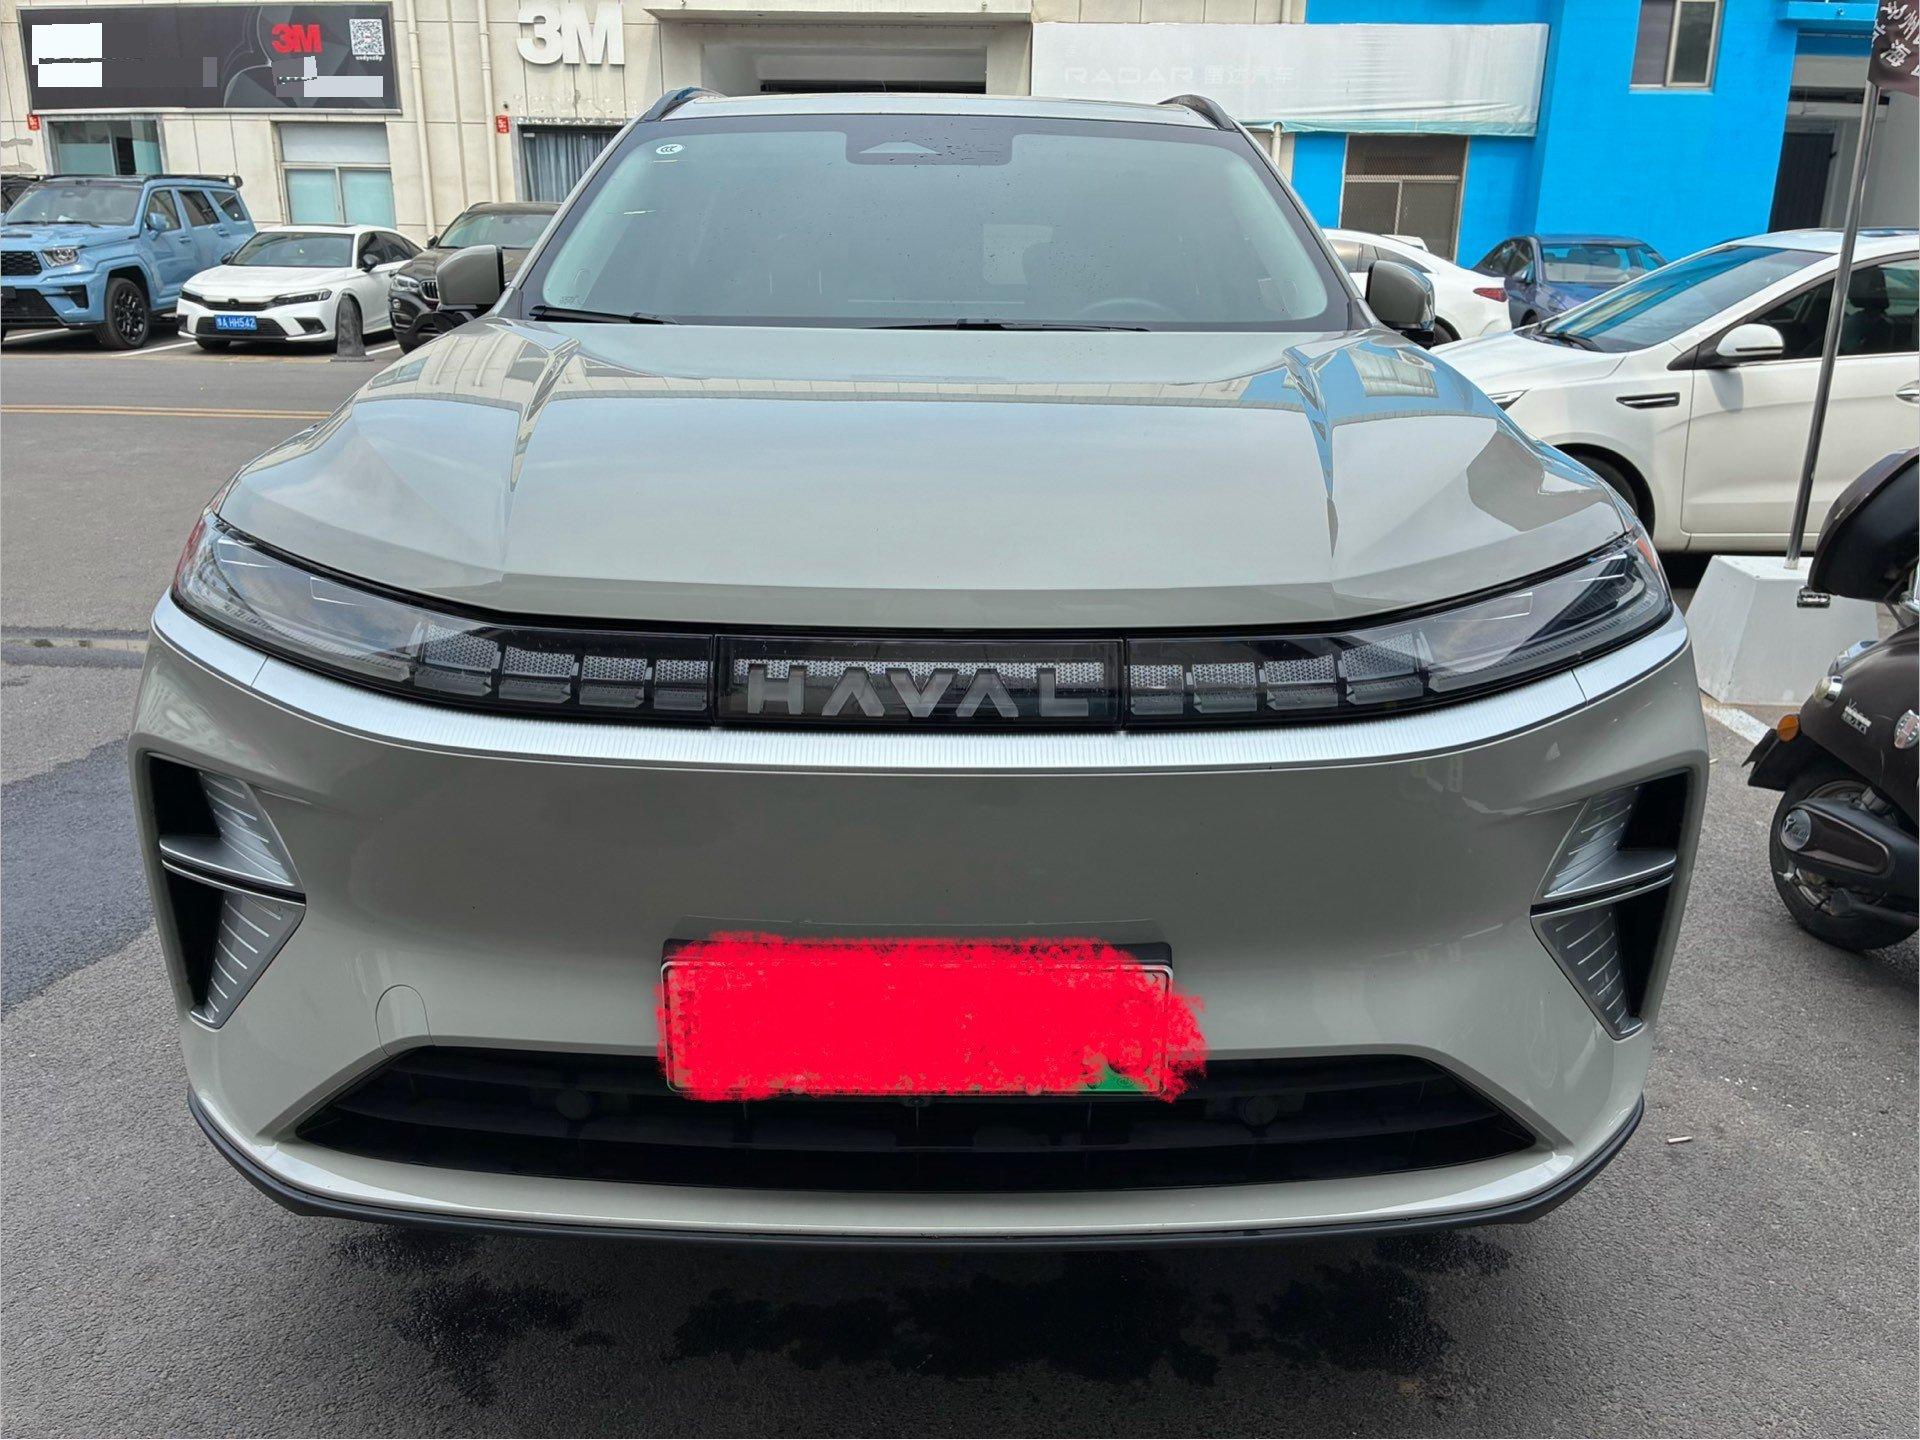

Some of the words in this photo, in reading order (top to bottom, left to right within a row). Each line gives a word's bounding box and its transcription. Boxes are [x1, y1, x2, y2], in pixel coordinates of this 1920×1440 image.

[271, 23, 323, 53] 3M
[516, 1, 625, 65] 3M
[1065, 67, 1194, 85] RADAR
[747, 665, 1090, 718] HAVAL
